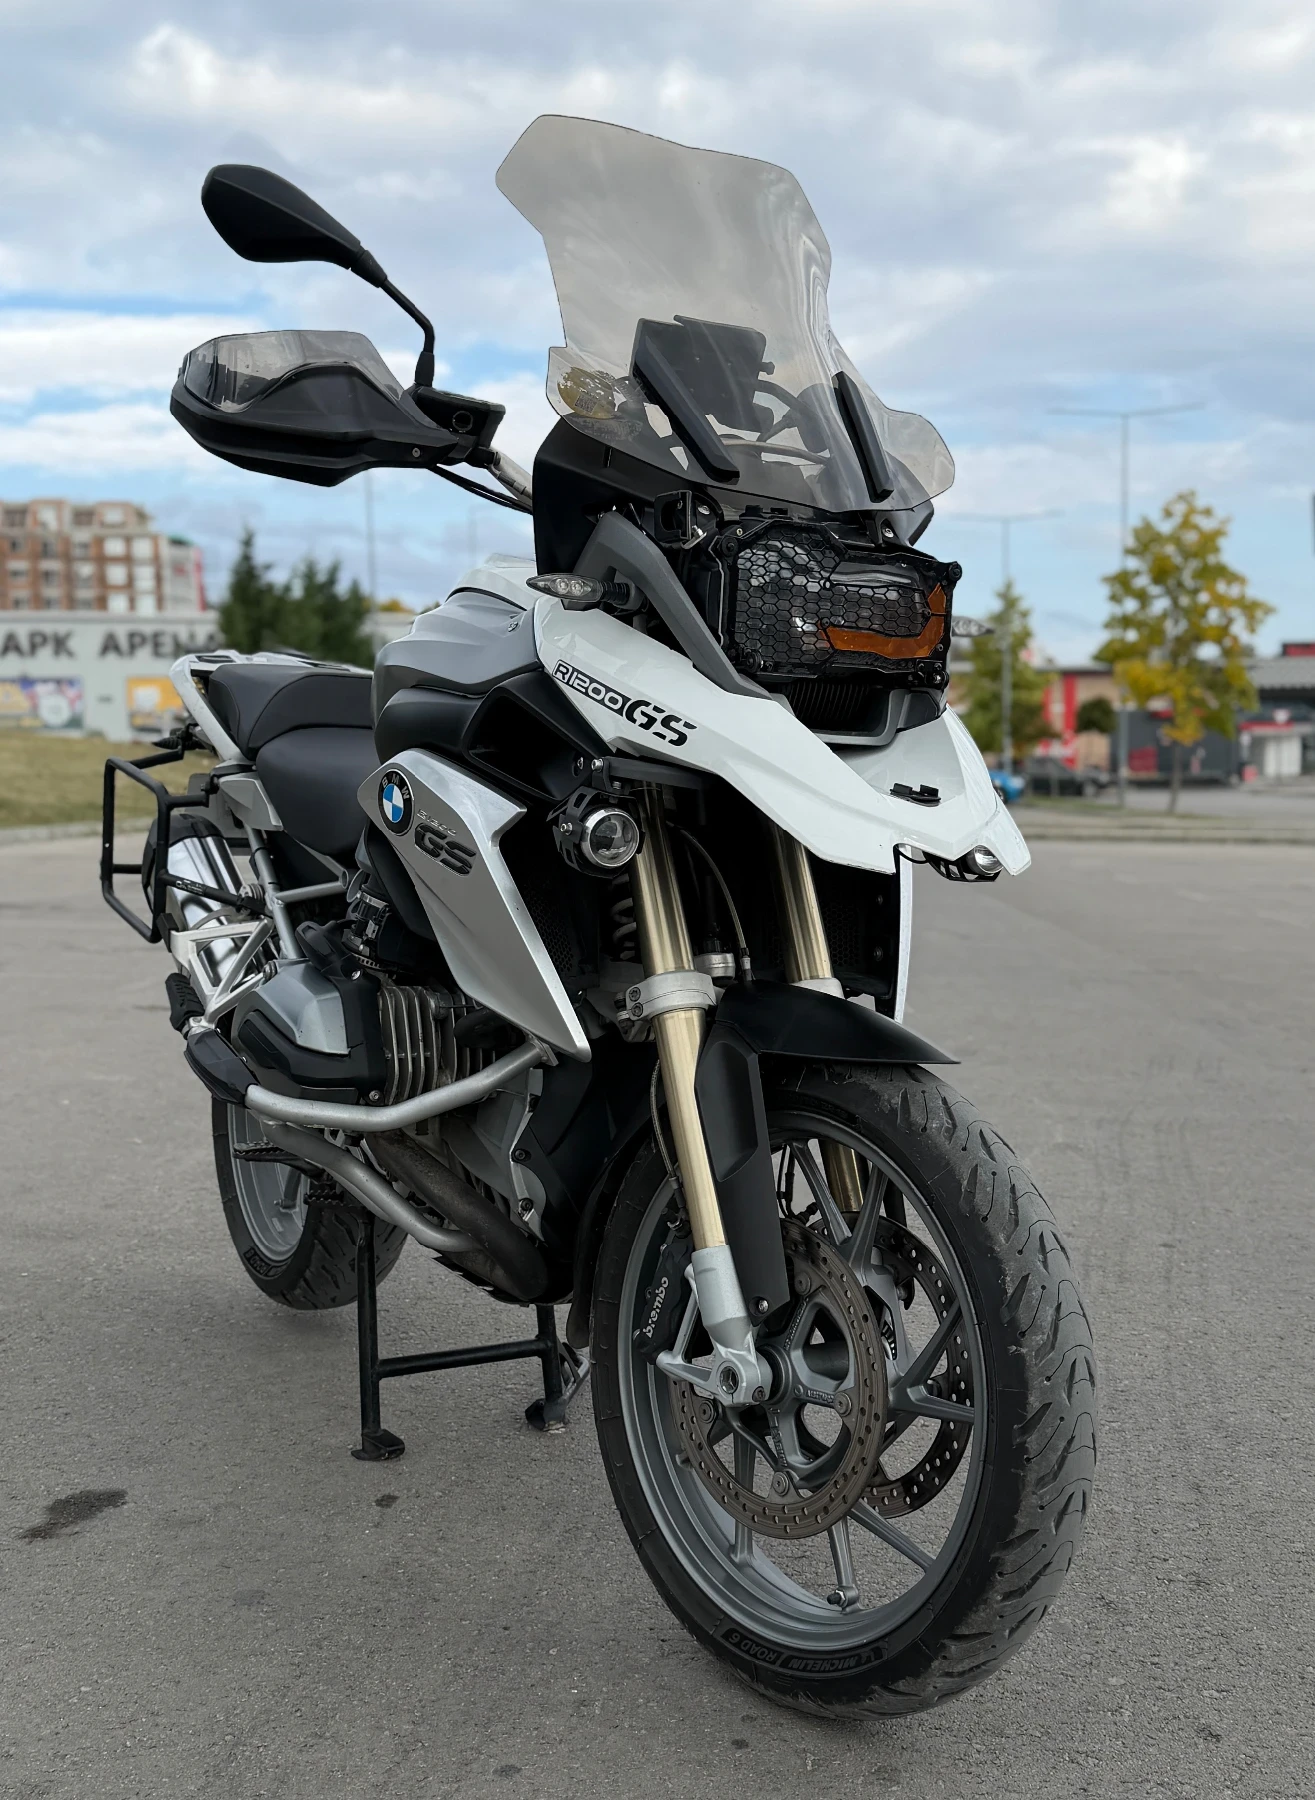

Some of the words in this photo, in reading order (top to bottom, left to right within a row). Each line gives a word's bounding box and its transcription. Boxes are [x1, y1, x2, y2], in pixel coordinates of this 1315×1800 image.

[381, 773, 411, 800] BMW
[414, 822, 477, 876] GS
[643, 1276, 669, 1338] brembo
[728, 1633, 739, 1643] 6
[740, 1638, 777, 1662] ROAD
[788, 1655, 859, 1671] MICHELIN
